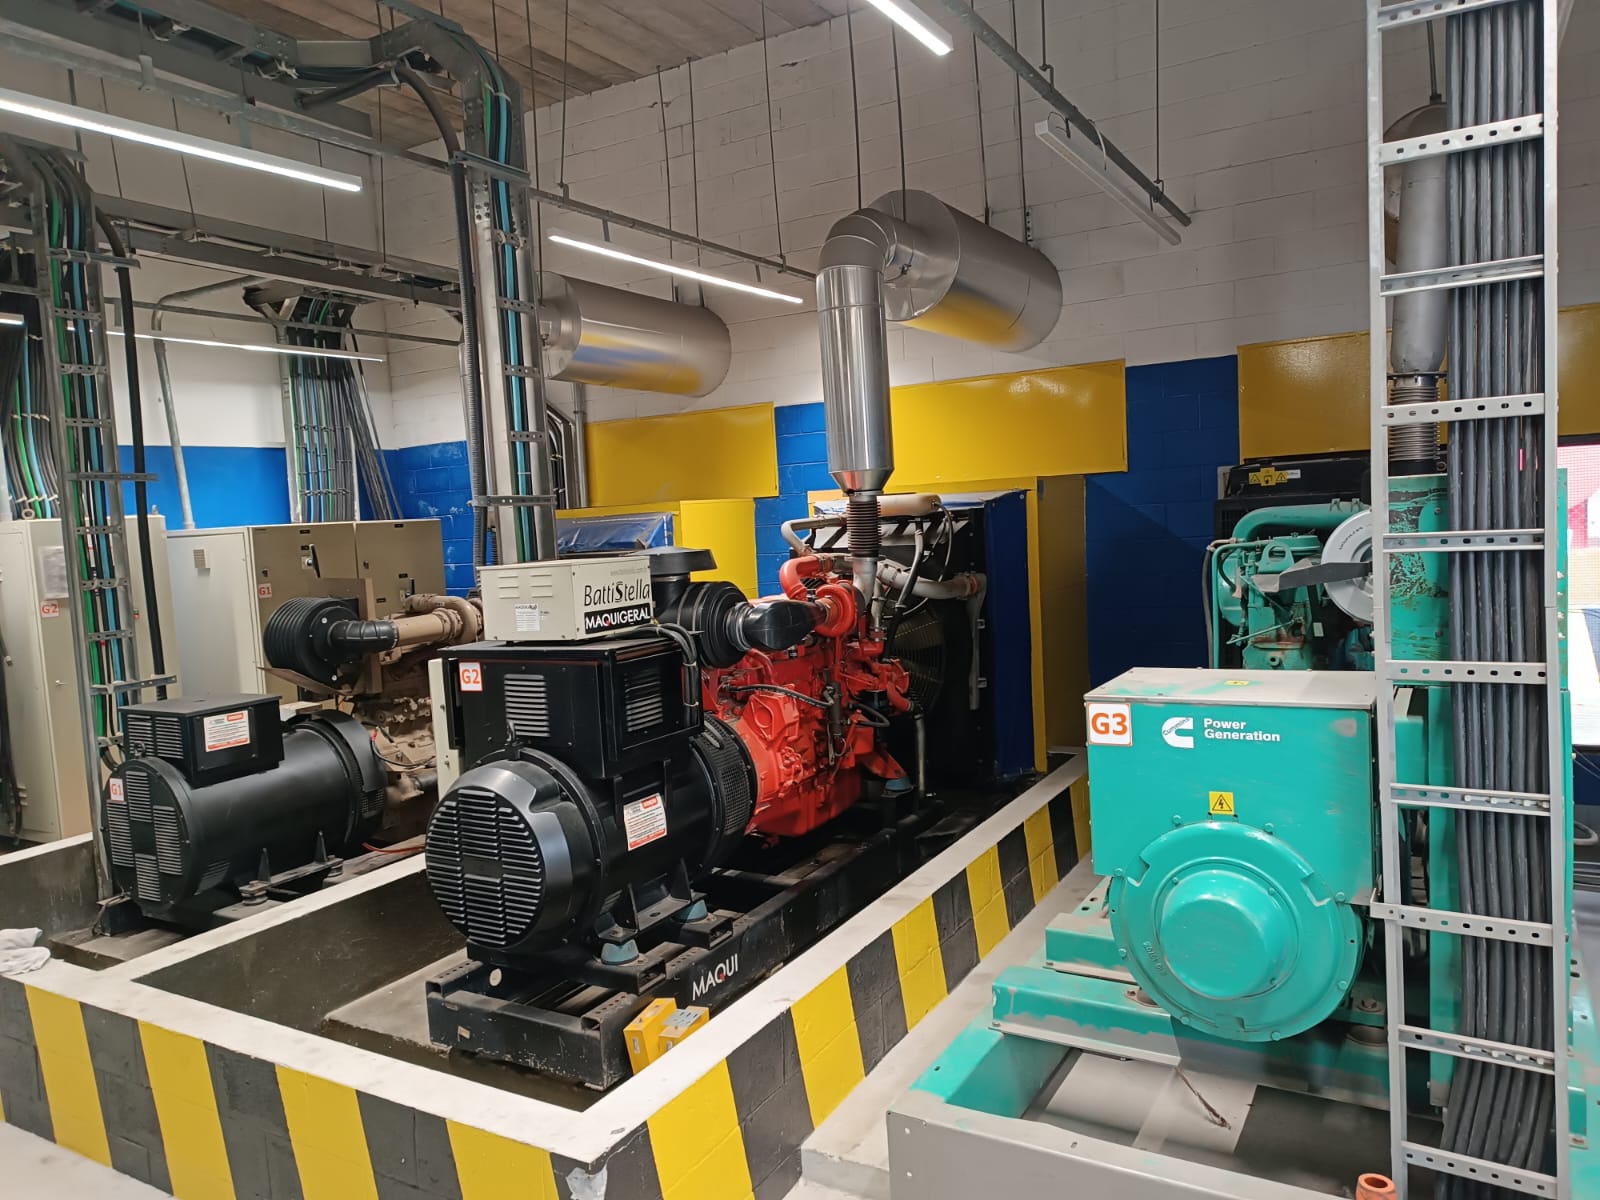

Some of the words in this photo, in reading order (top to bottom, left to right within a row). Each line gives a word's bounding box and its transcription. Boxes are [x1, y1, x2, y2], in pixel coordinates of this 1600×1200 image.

[259, 586, 271, 595] G1
[42, 604, 58, 614] G2
[585, 607, 650, 630] MAQUIGERAL
[461, 669, 480, 685] G2
[1091, 713, 1128, 736] G3
[1203, 718, 1246, 730] Power
[1204, 729, 1280, 742] Generation
[111, 784, 122, 796] G1
[692, 953, 739, 1001] MAQUI
